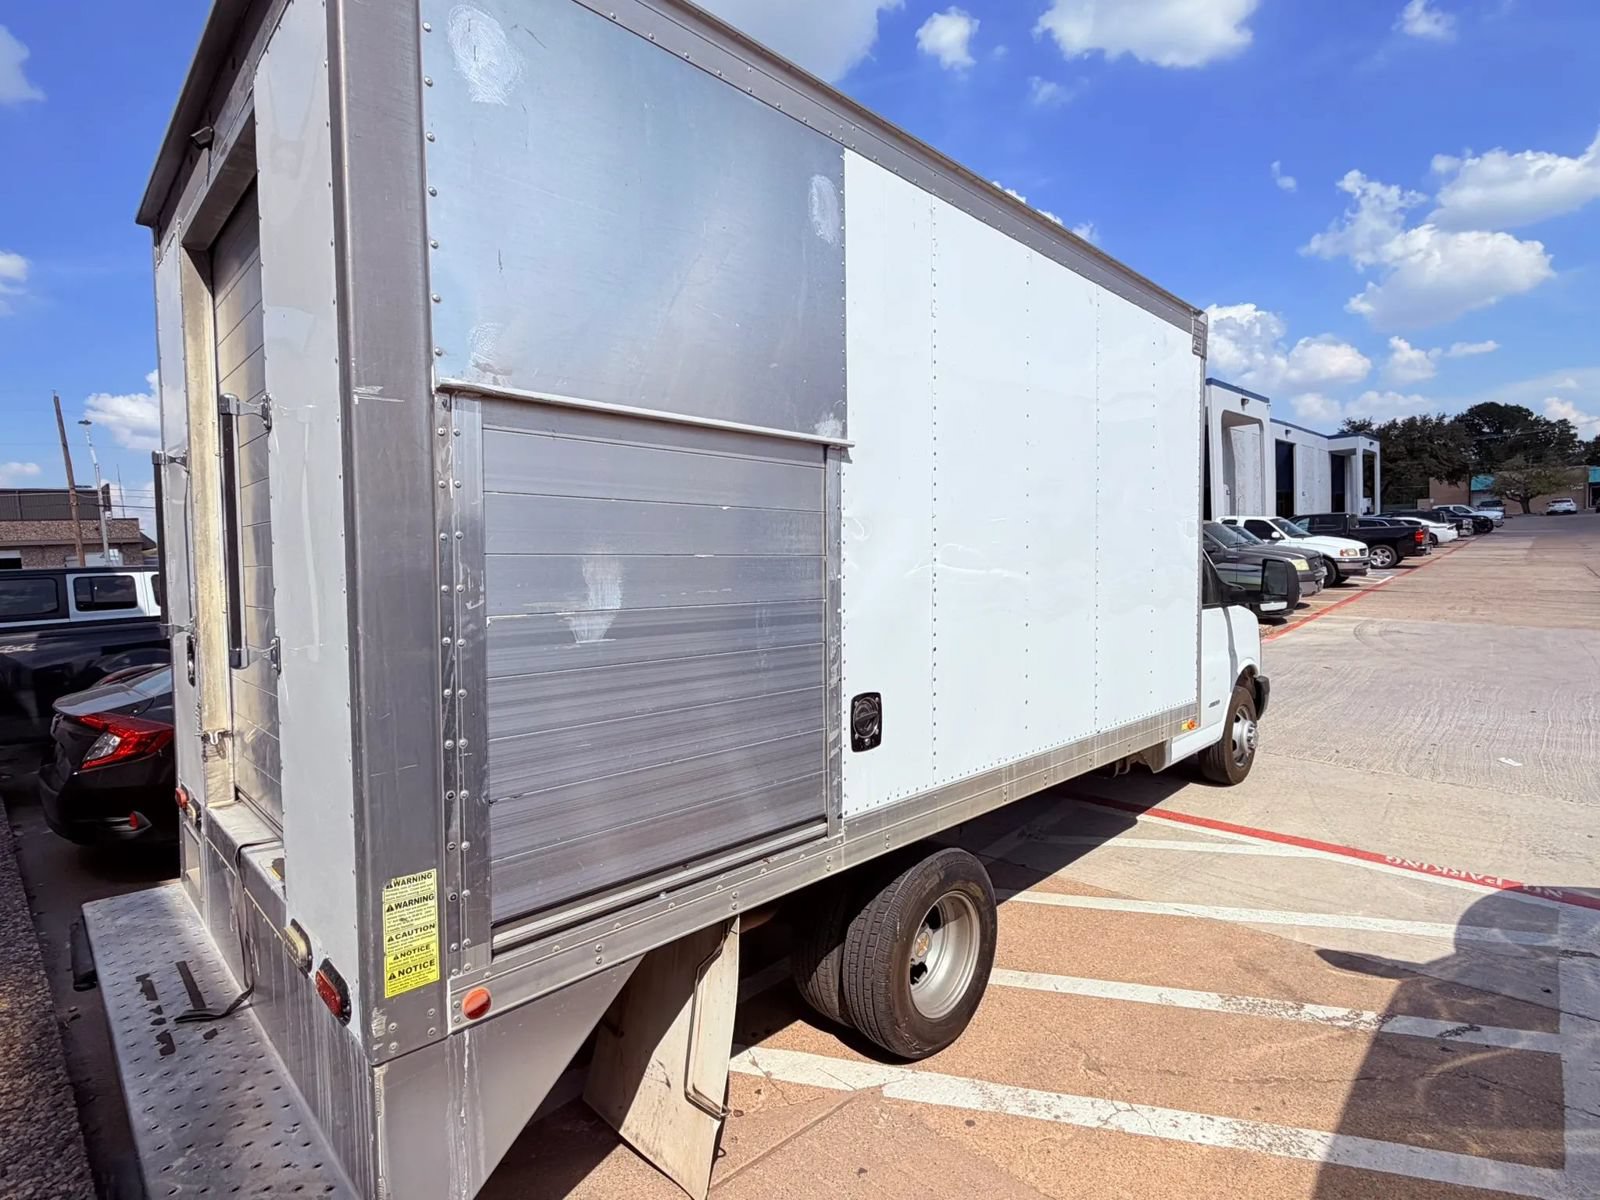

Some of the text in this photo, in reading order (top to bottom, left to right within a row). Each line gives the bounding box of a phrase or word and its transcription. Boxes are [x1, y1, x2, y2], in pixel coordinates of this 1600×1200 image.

[392, 872, 432, 887] WARNING
[1386, 856, 1502, 886] PARKING
[394, 893, 435, 910] WARNING
[395, 923, 436, 940] CAUTION
[400, 944, 431, 958] NOTICE
[398, 959, 435, 977] NOTICE
